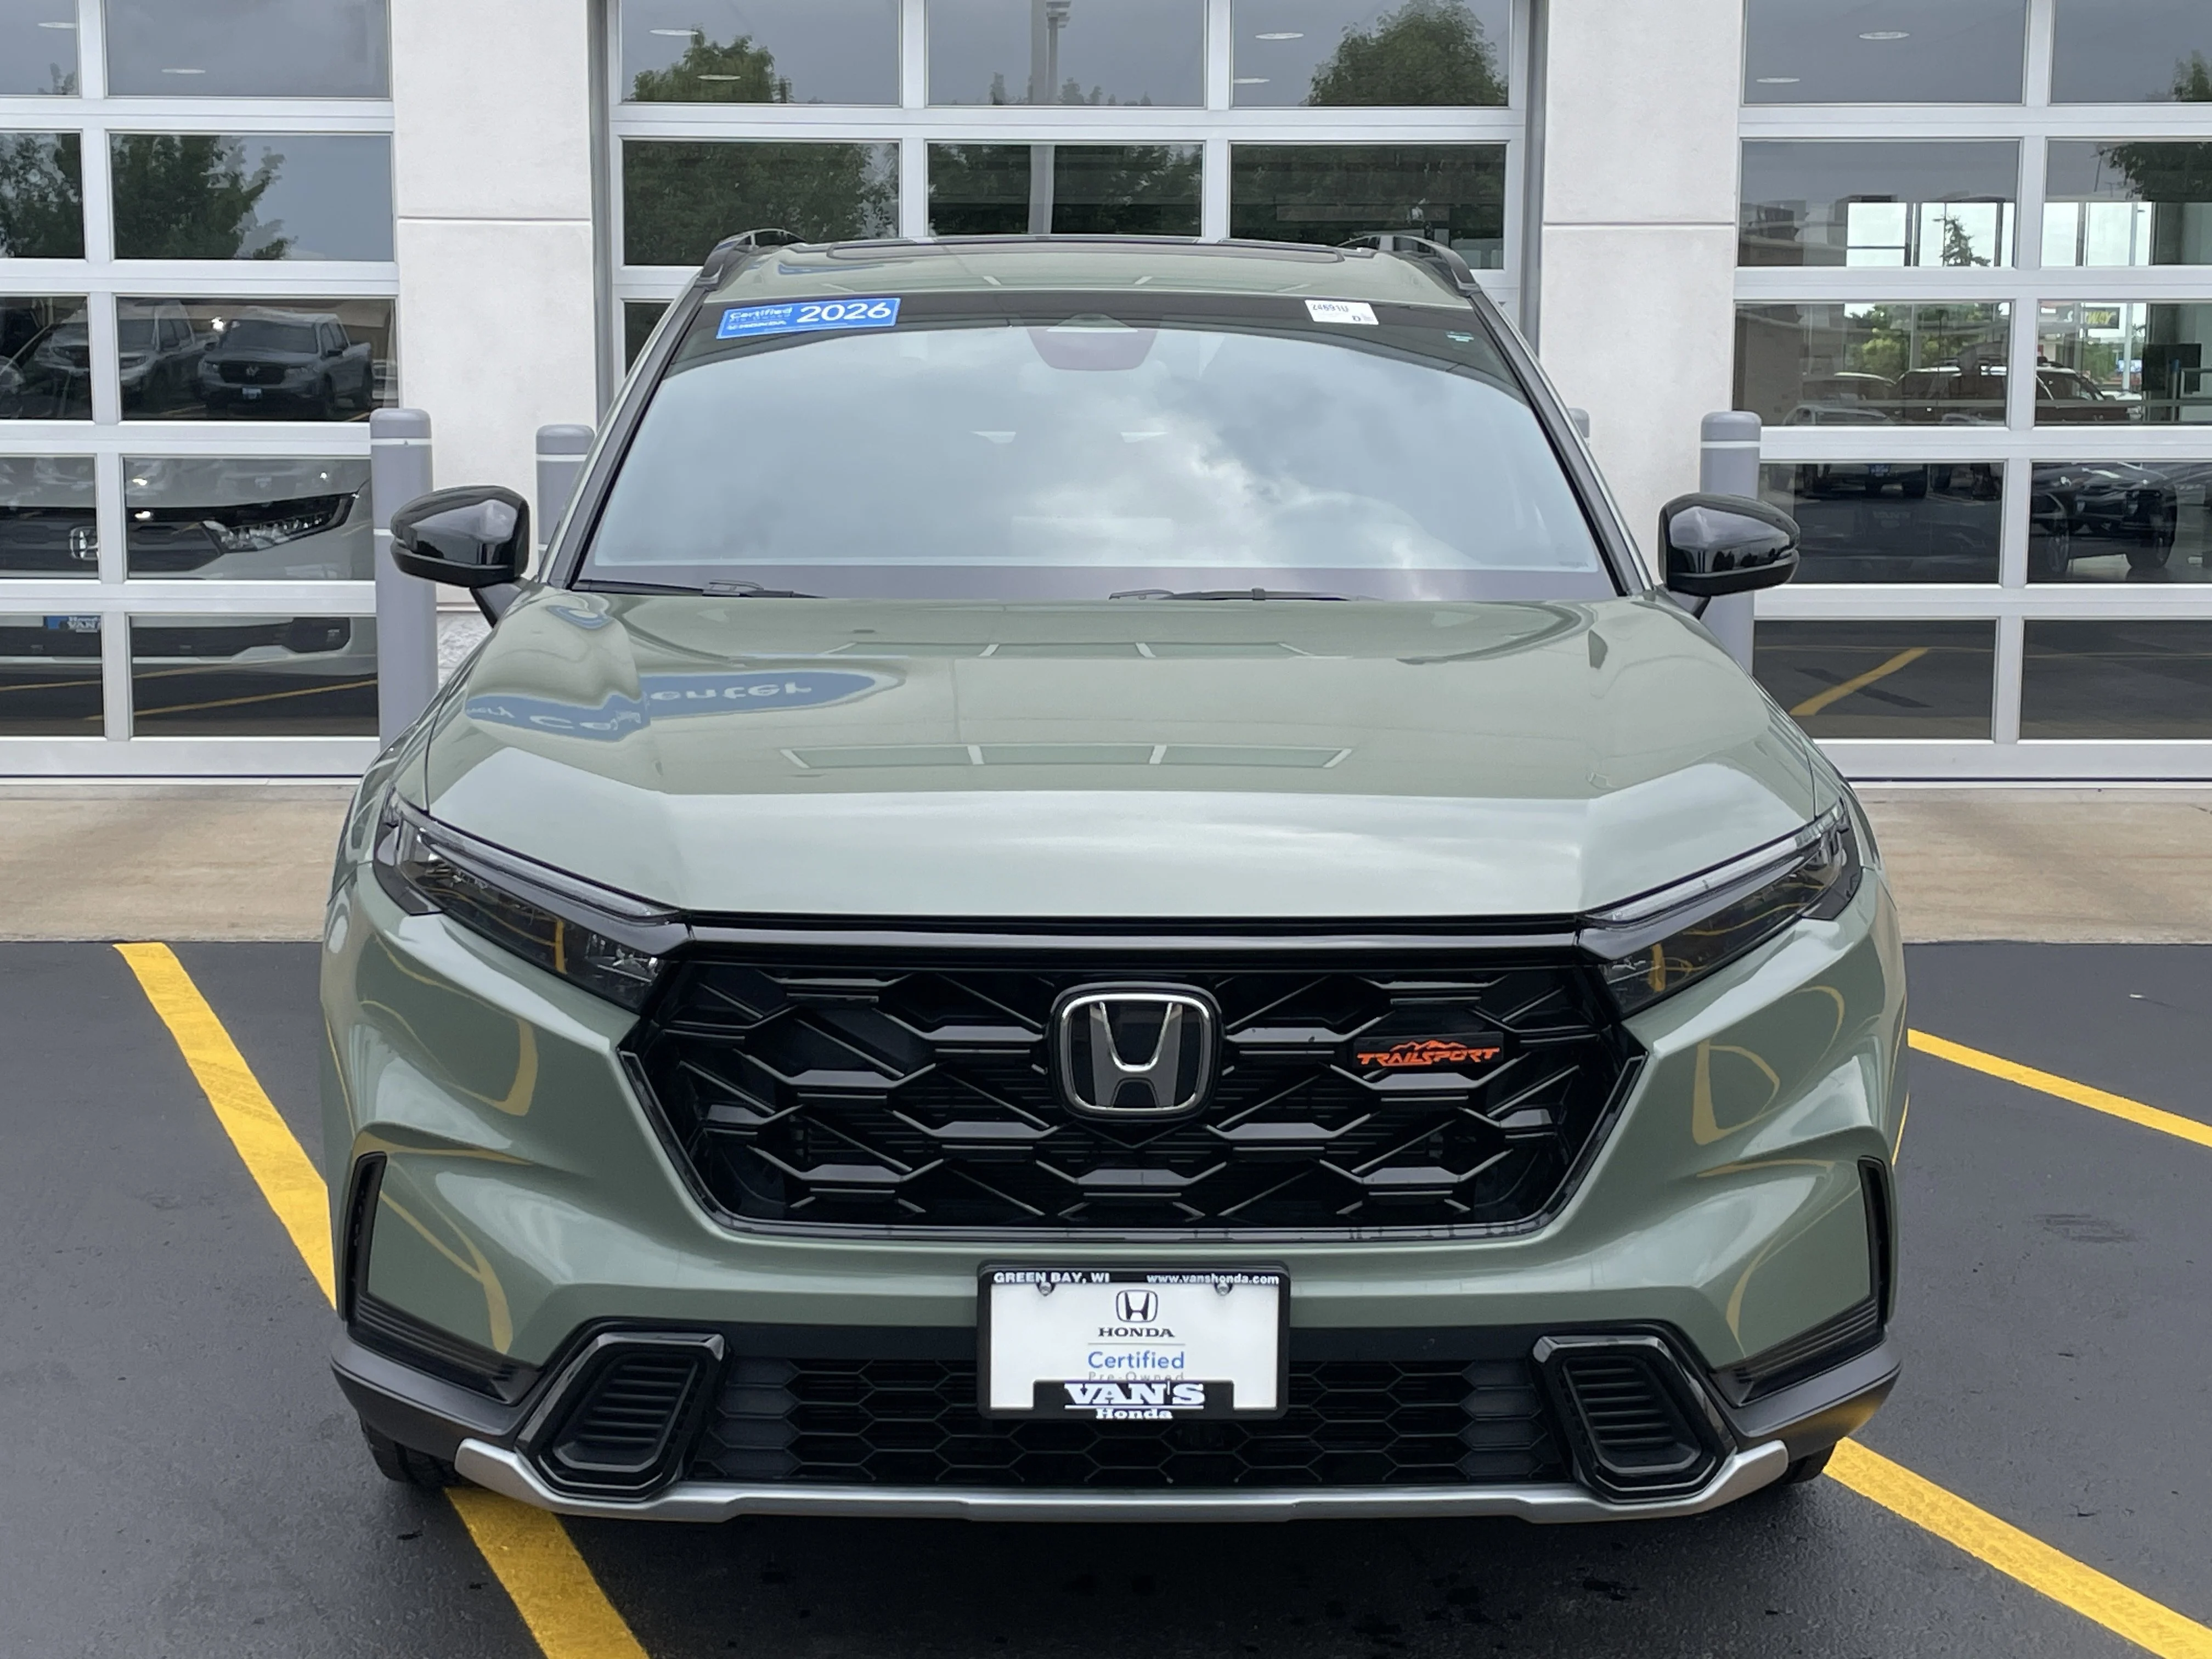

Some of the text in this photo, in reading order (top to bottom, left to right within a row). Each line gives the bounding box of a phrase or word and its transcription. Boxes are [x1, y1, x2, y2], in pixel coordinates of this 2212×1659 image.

[797, 303, 891, 323] 2026
[1357, 1047, 1500, 1067] TRAILSPORT
[994, 1272, 1046, 1284] GREEN
[1091, 1273, 1110, 1283] WI
[1146, 1273, 1280, 1285] www.vanshonda.com
[1098, 1327, 1176, 1338] HONDA
[1087, 1351, 1185, 1369] Certified
[1064, 1380, 1206, 1405] VAN'S
[1096, 1408, 1173, 1420] Honda
